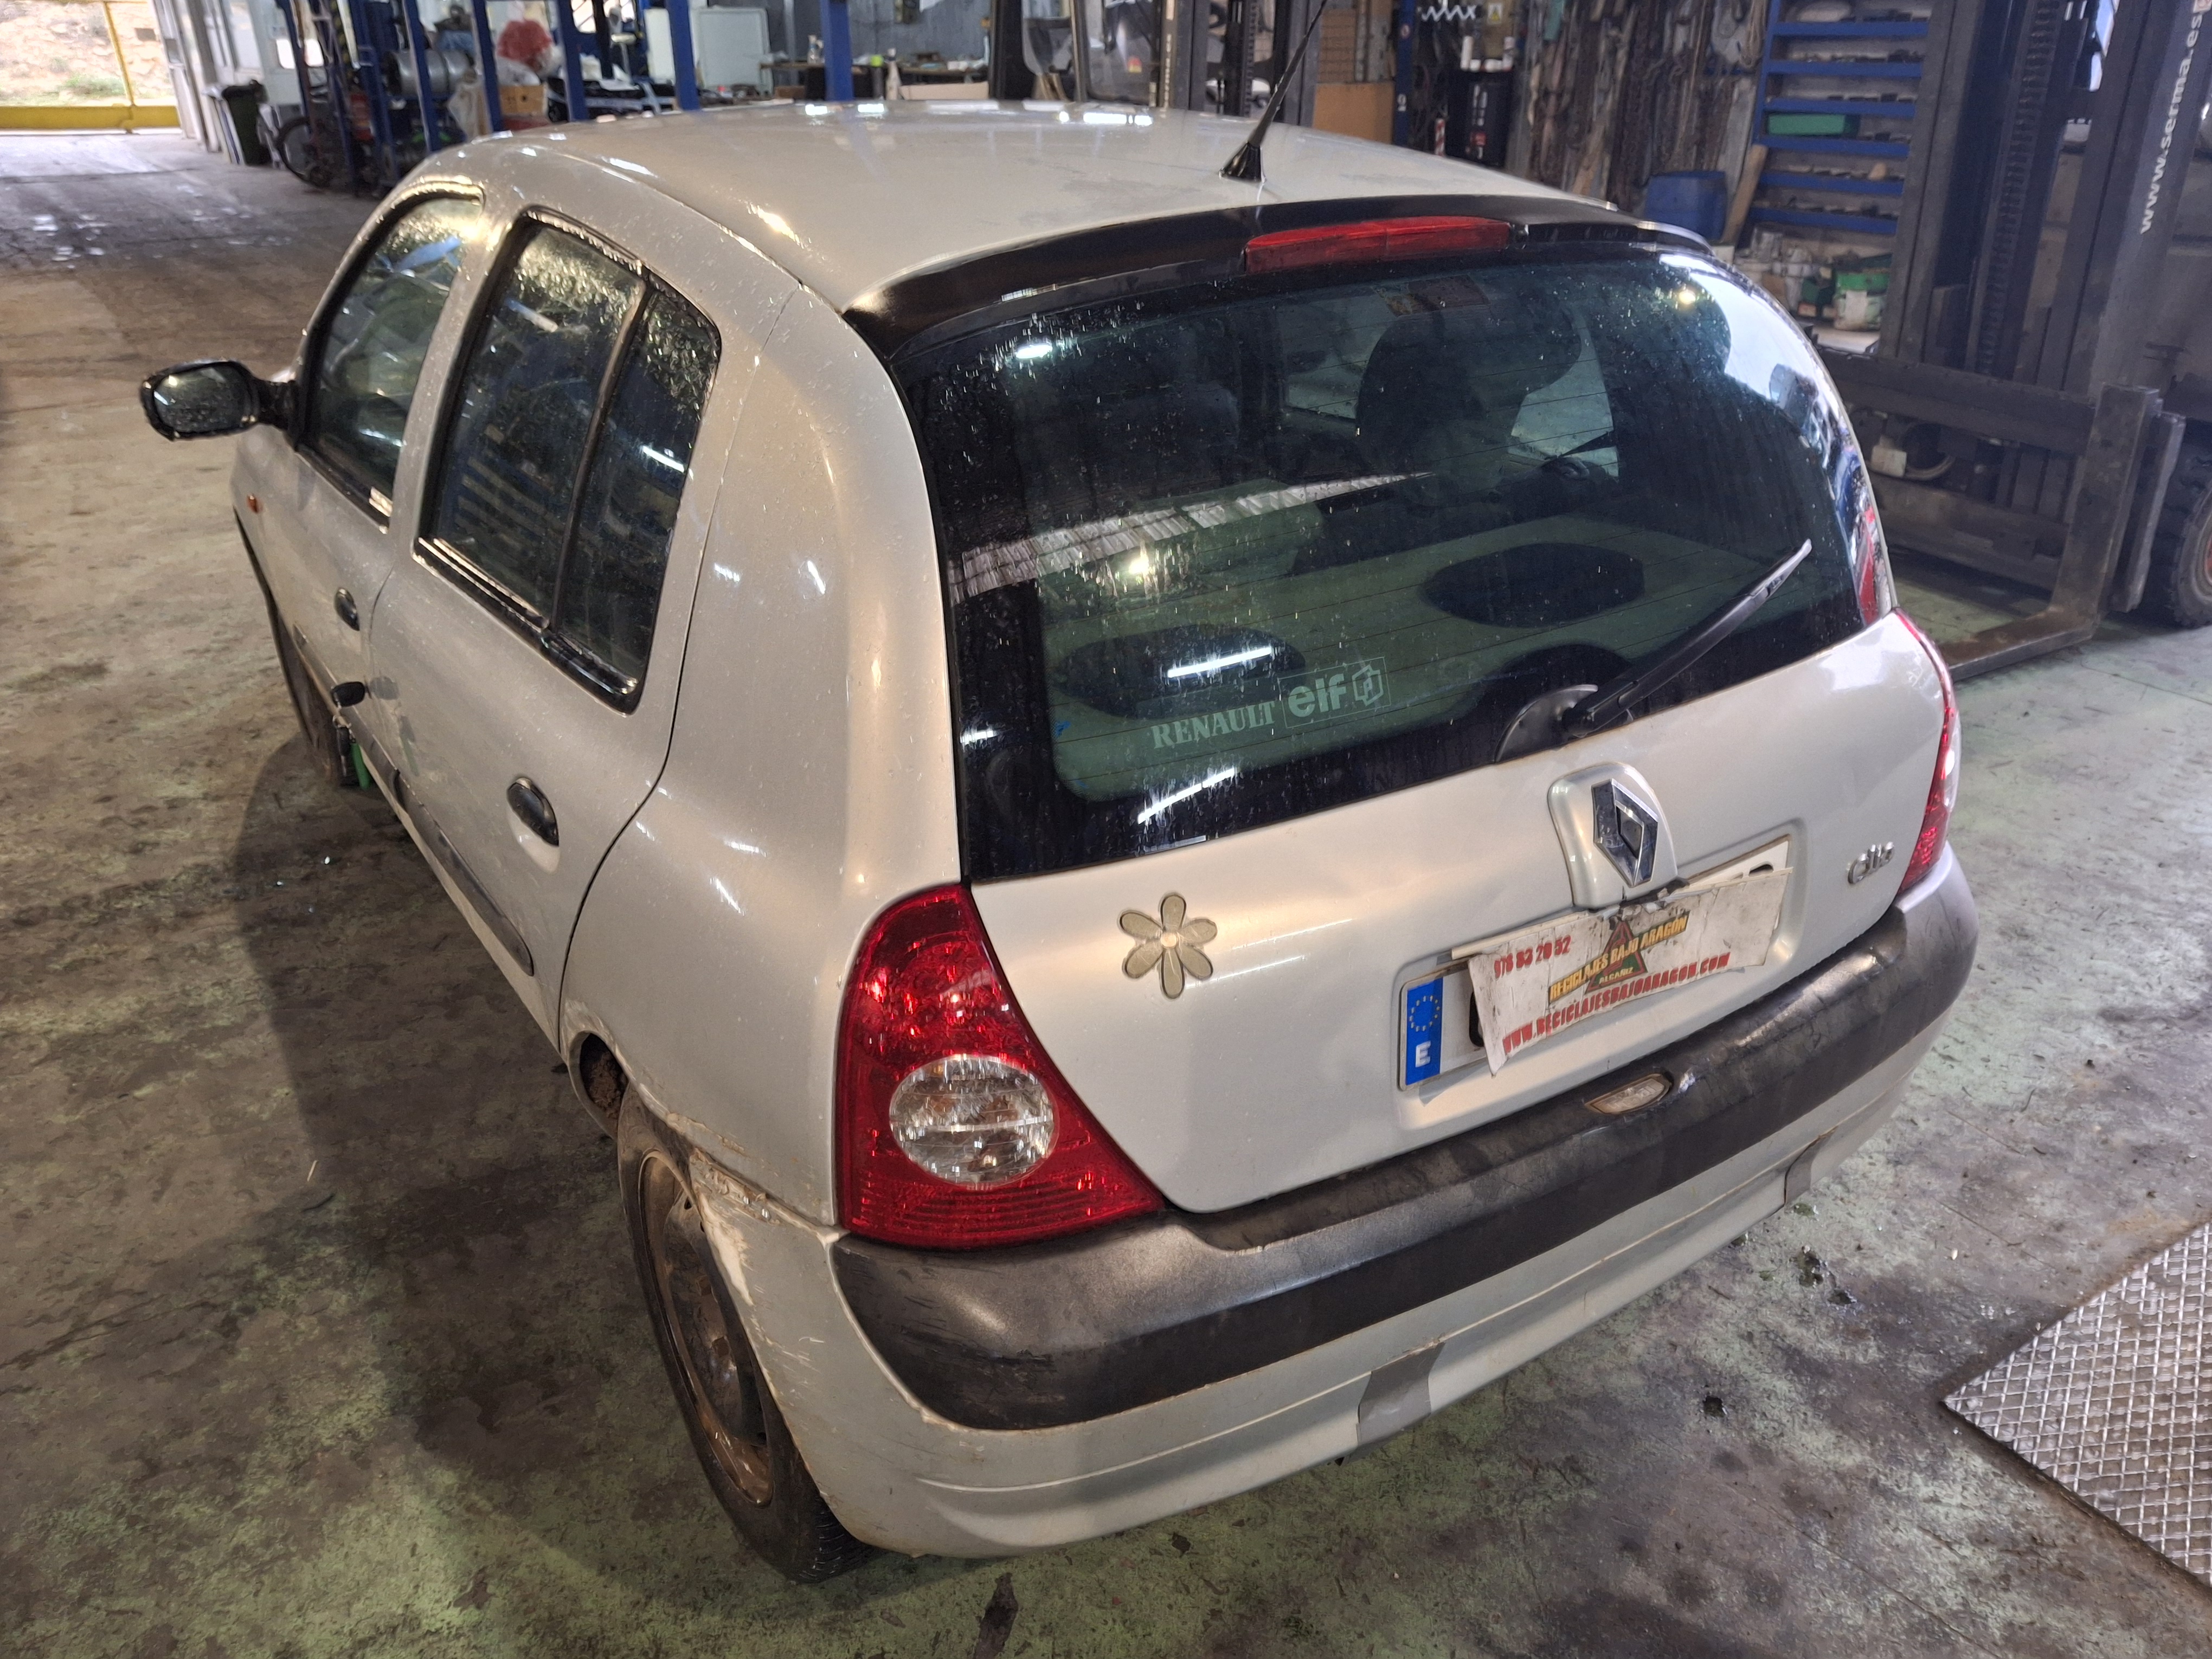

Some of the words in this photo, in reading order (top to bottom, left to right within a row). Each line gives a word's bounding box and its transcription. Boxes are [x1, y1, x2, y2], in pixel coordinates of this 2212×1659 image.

[2140, 13, 2203, 234] www.serma.es
[1150, 701, 1275, 749] RENAULT
[1288, 673, 1347, 717] elf
[1549, 953, 1609, 1002] RECICLAJES
[1610, 936, 1639, 966] BAJO
[1554, 934, 1571, 957] 52
[1599, 967, 1634, 985] ALCAÑIZ
[1502, 951, 1731, 1056] WWW.RECICLAJESBAJOARAGON.COM
[1415, 1040, 1431, 1068] E
